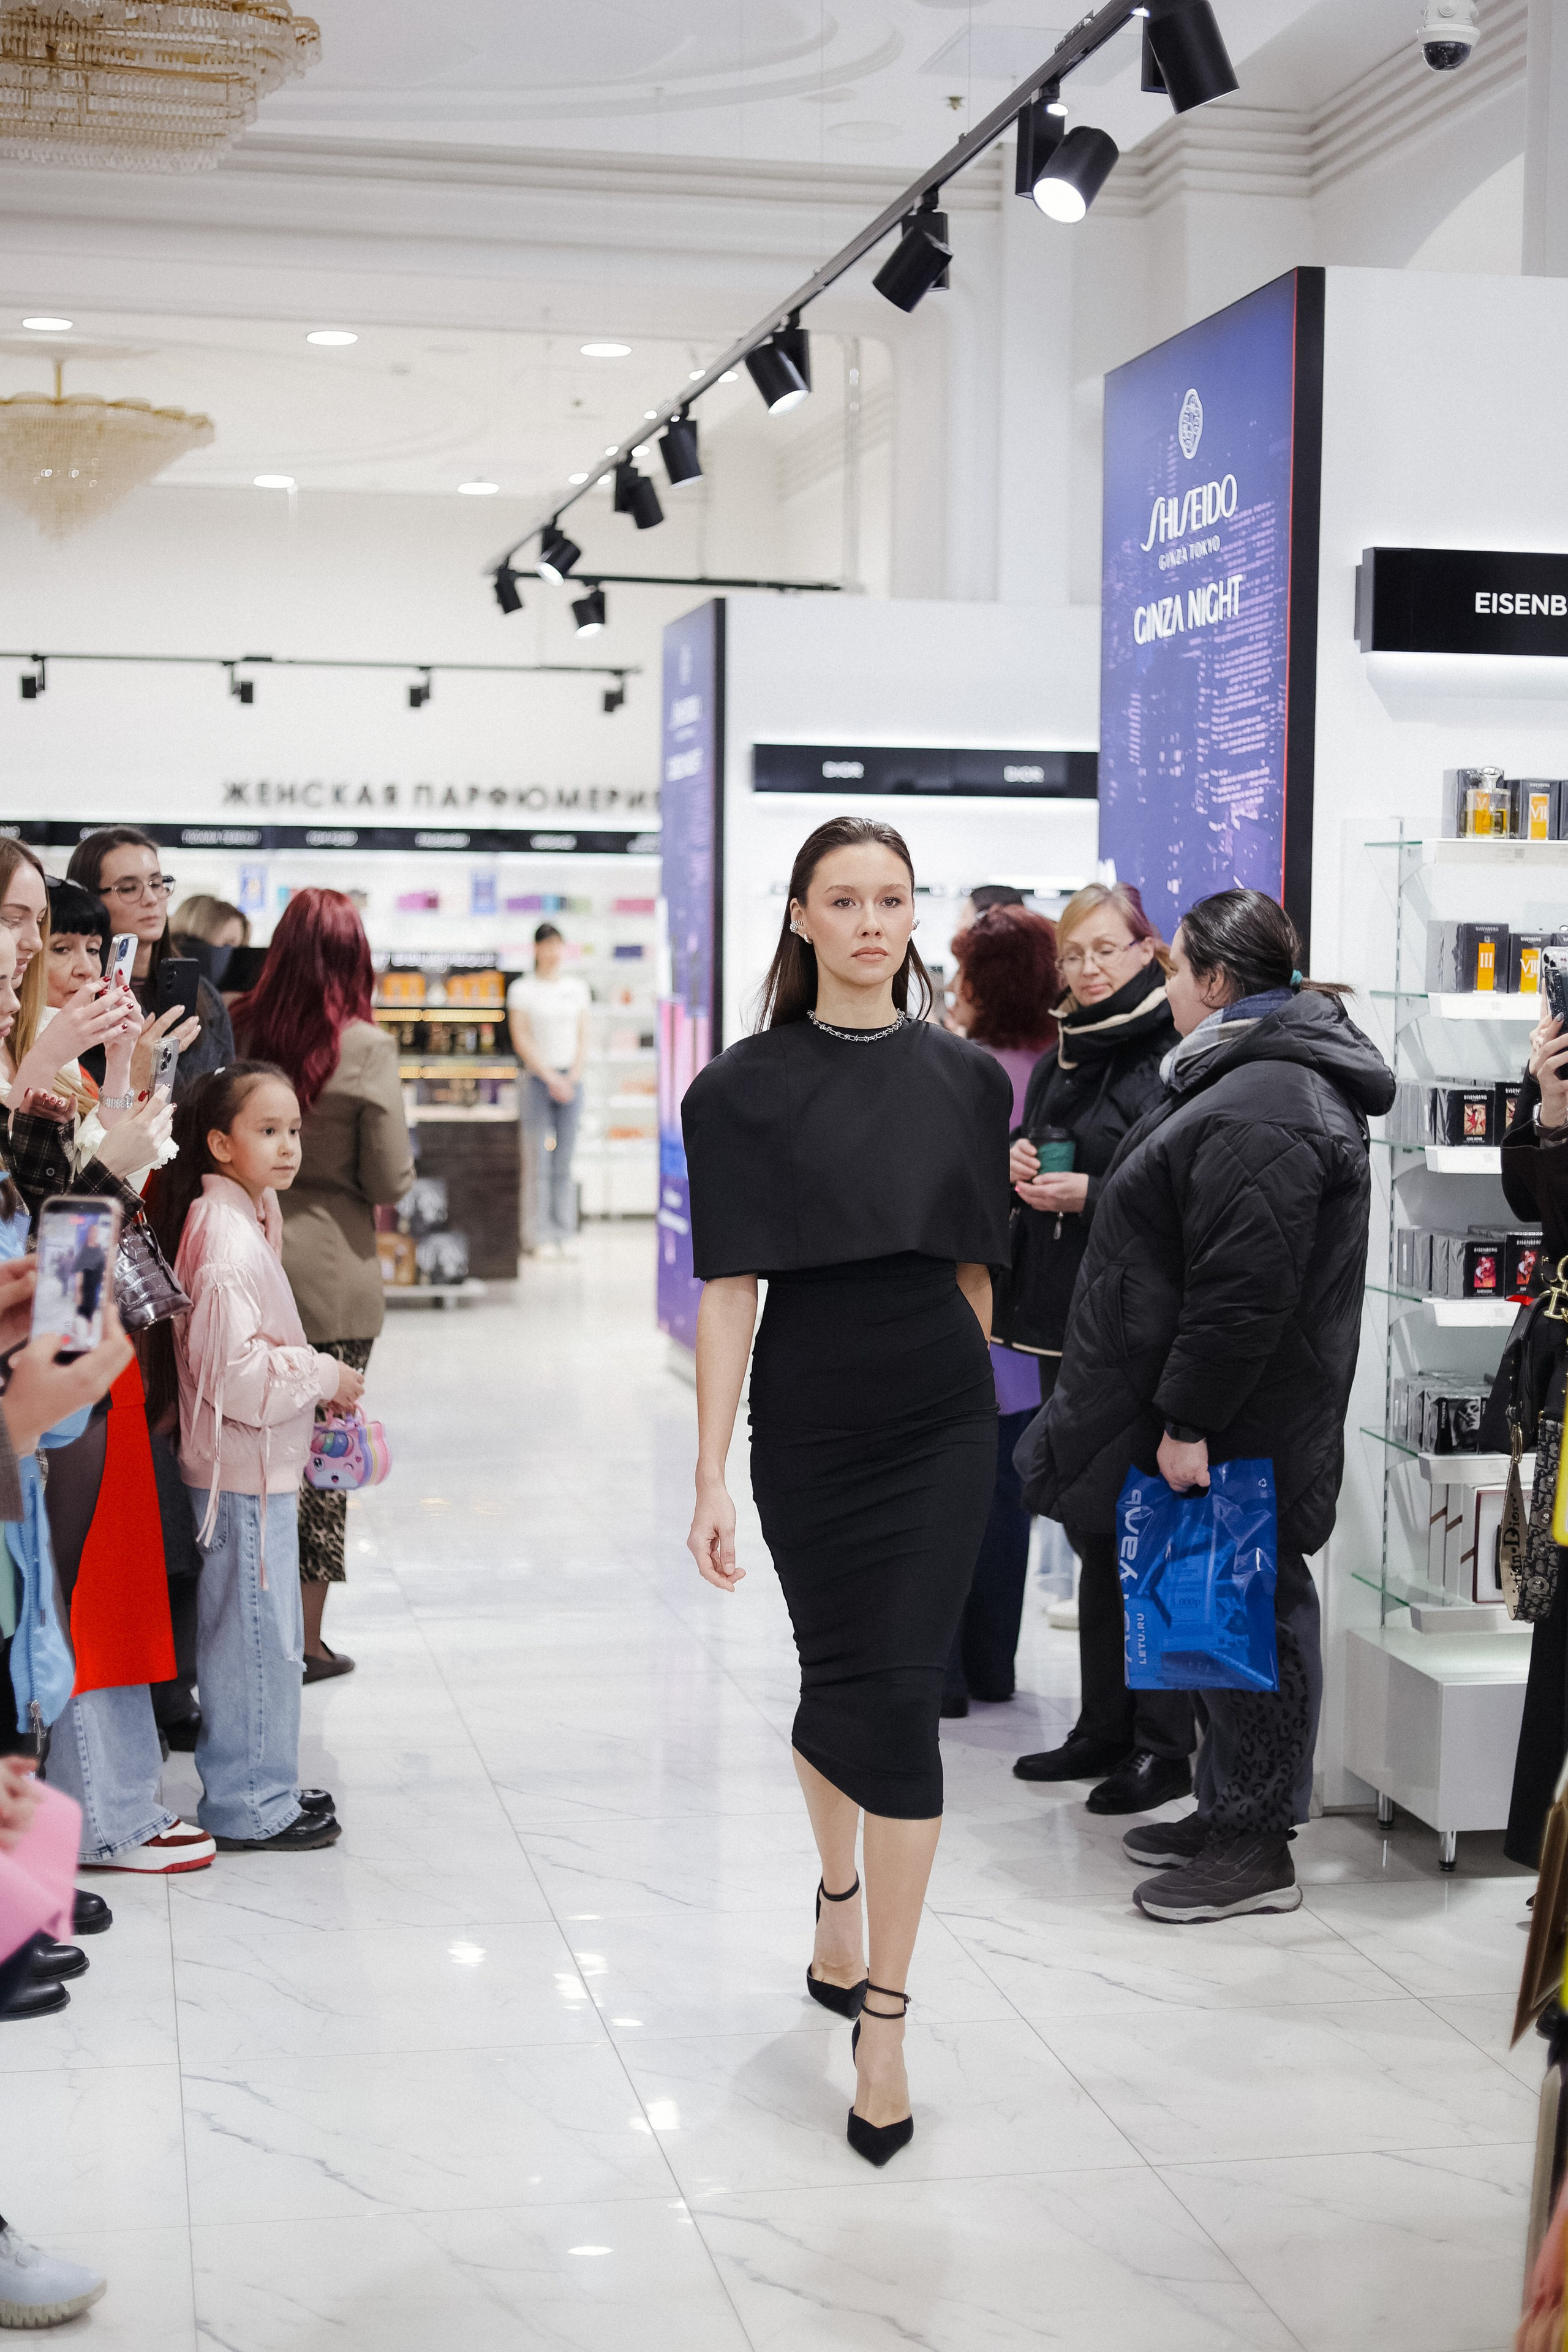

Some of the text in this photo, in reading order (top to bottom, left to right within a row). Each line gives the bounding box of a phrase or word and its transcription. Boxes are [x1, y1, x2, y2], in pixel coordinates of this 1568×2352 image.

[1140, 473, 1238, 552] SHISEIDO
[1158, 535, 1221, 571] GINZA TOKYO
[1133, 573, 1243, 645] GINZA NIGHT
[222, 782, 396, 808] ЖЕНСКАЯ
[1137, 1612, 1147, 1665] LETU.RU
